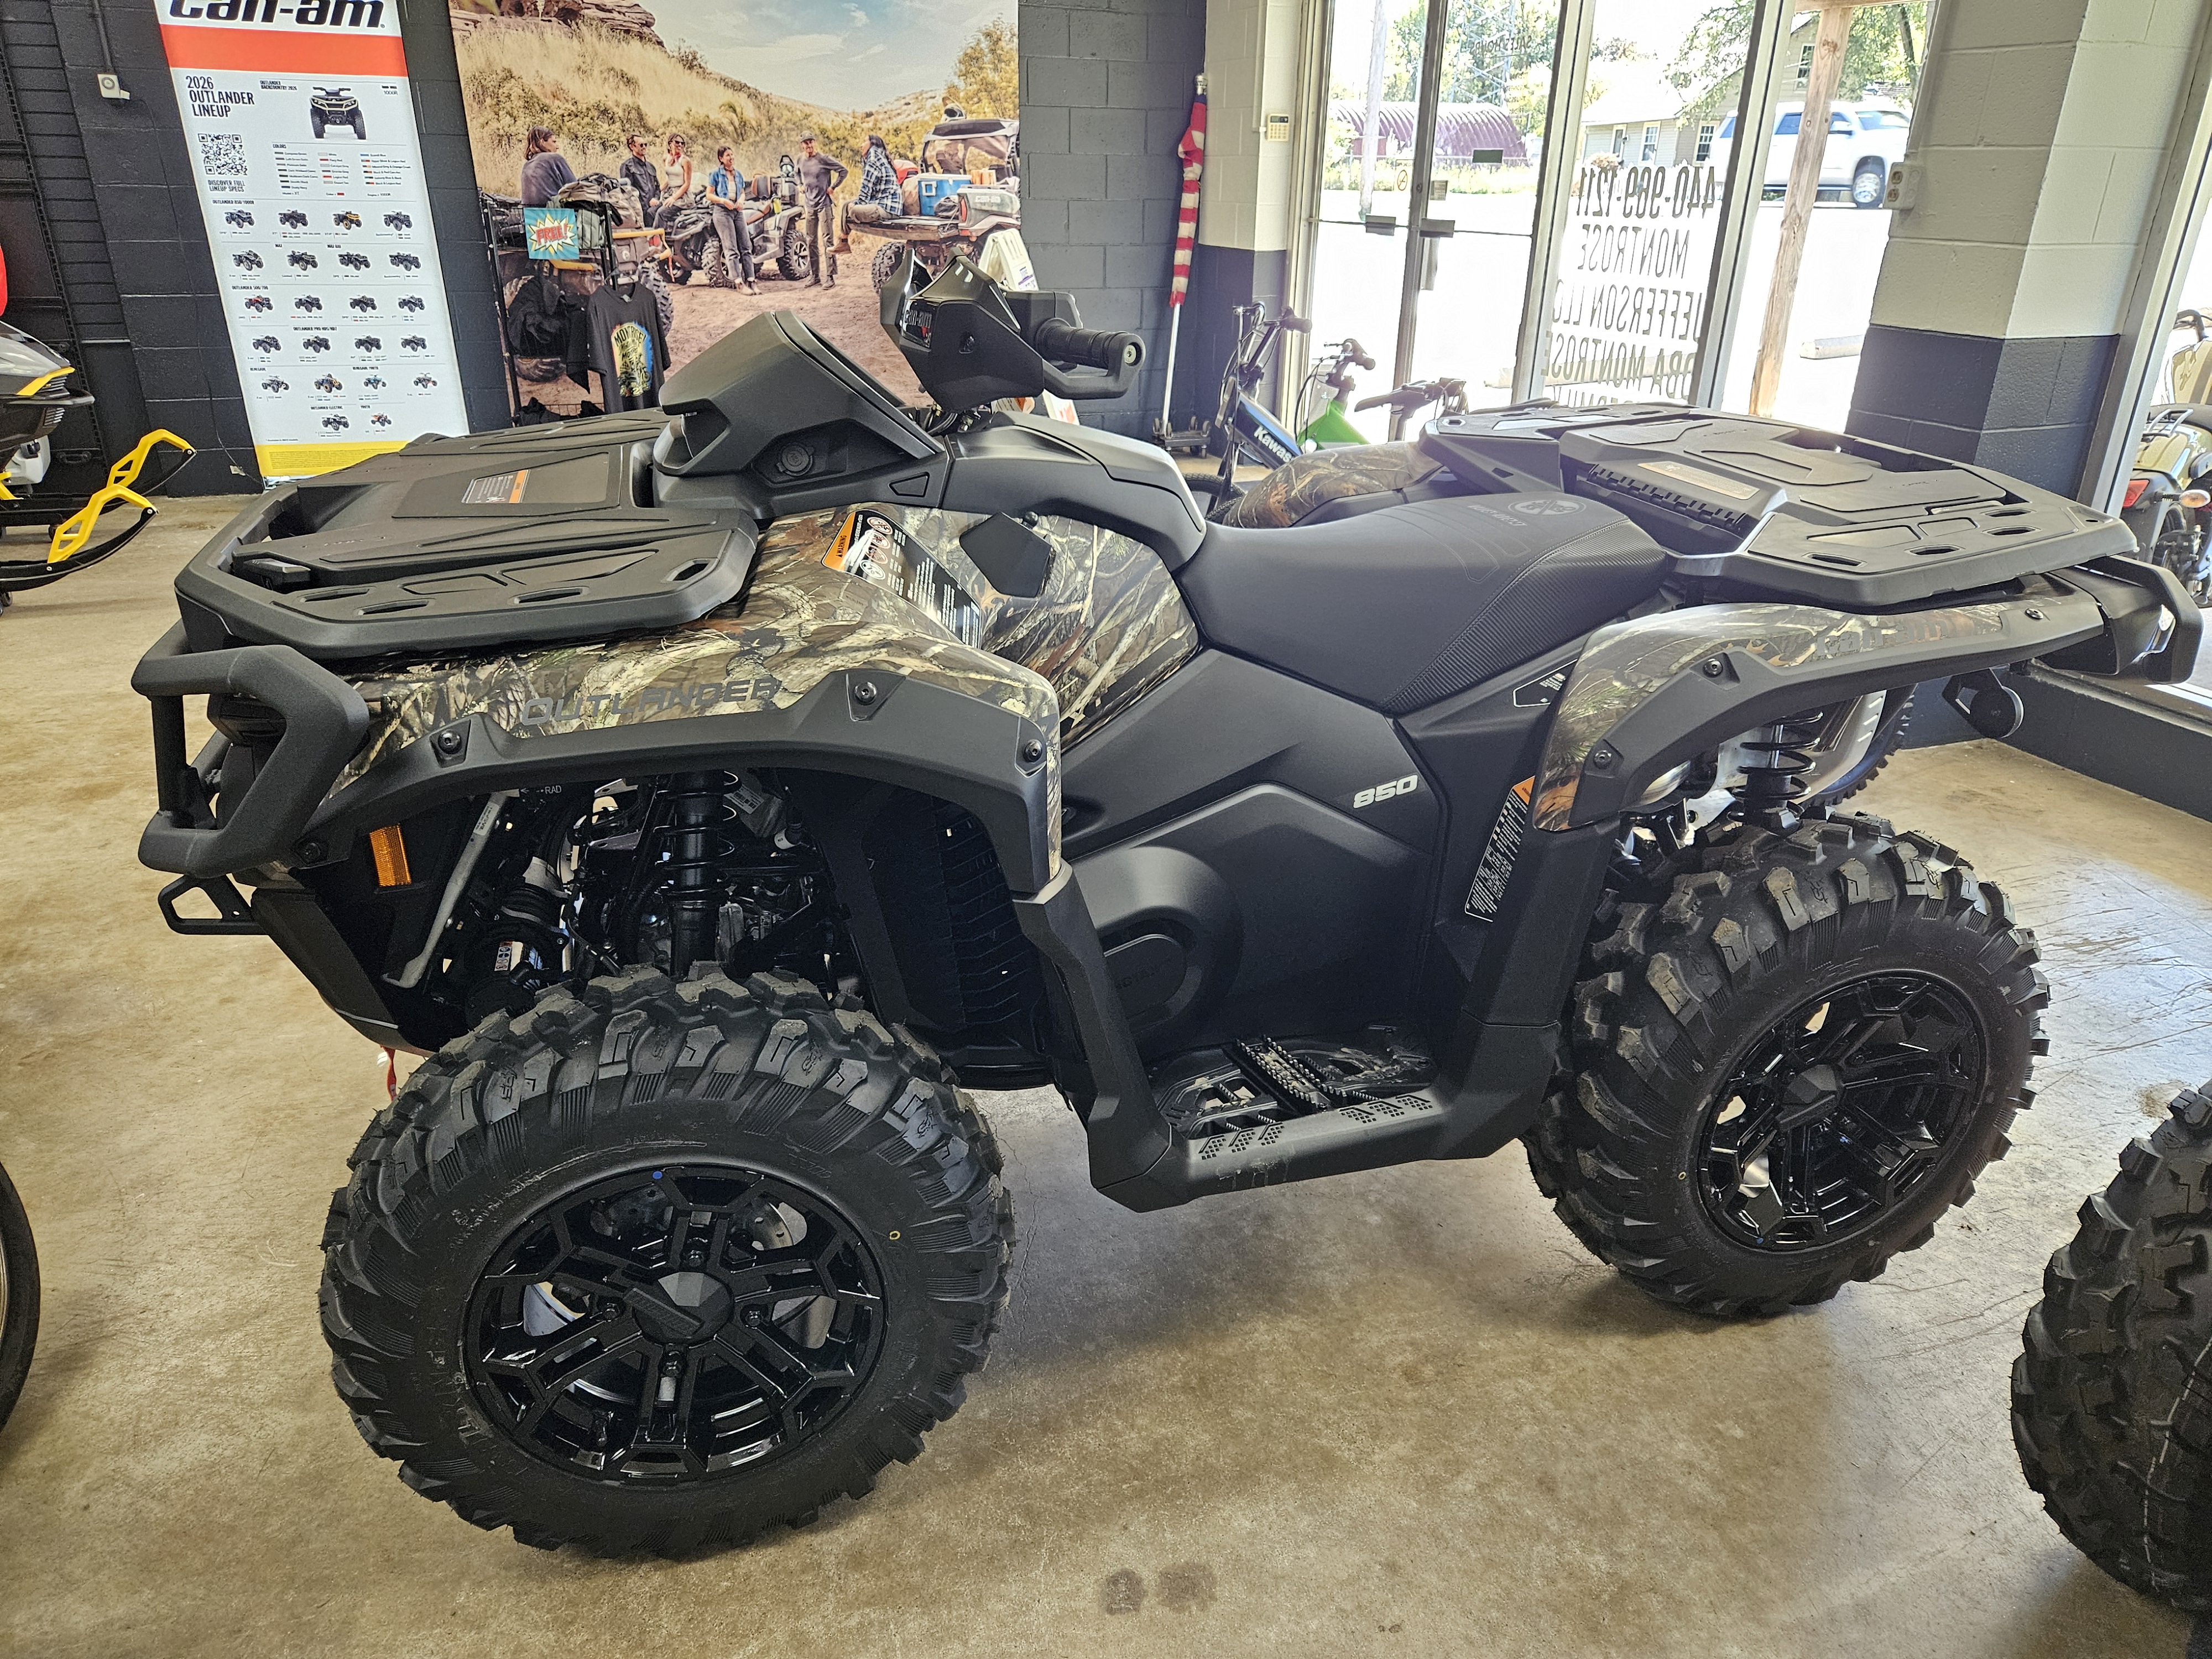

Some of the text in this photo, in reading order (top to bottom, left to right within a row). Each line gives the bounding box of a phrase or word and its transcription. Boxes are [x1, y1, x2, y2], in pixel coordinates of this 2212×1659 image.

[186, 76, 214, 89] 2026
[190, 90, 254, 105] OUTLANDER
[192, 104, 231, 117] LINEUP
[536, 223, 567, 246] FREE!
[1254, 426, 1293, 463] Kawas
[837, 535, 847, 554] WARNING
[521, 677, 782, 726] OUTLANDER
[545, 785, 562, 794] RAD
[1353, 774, 1418, 808] 850
